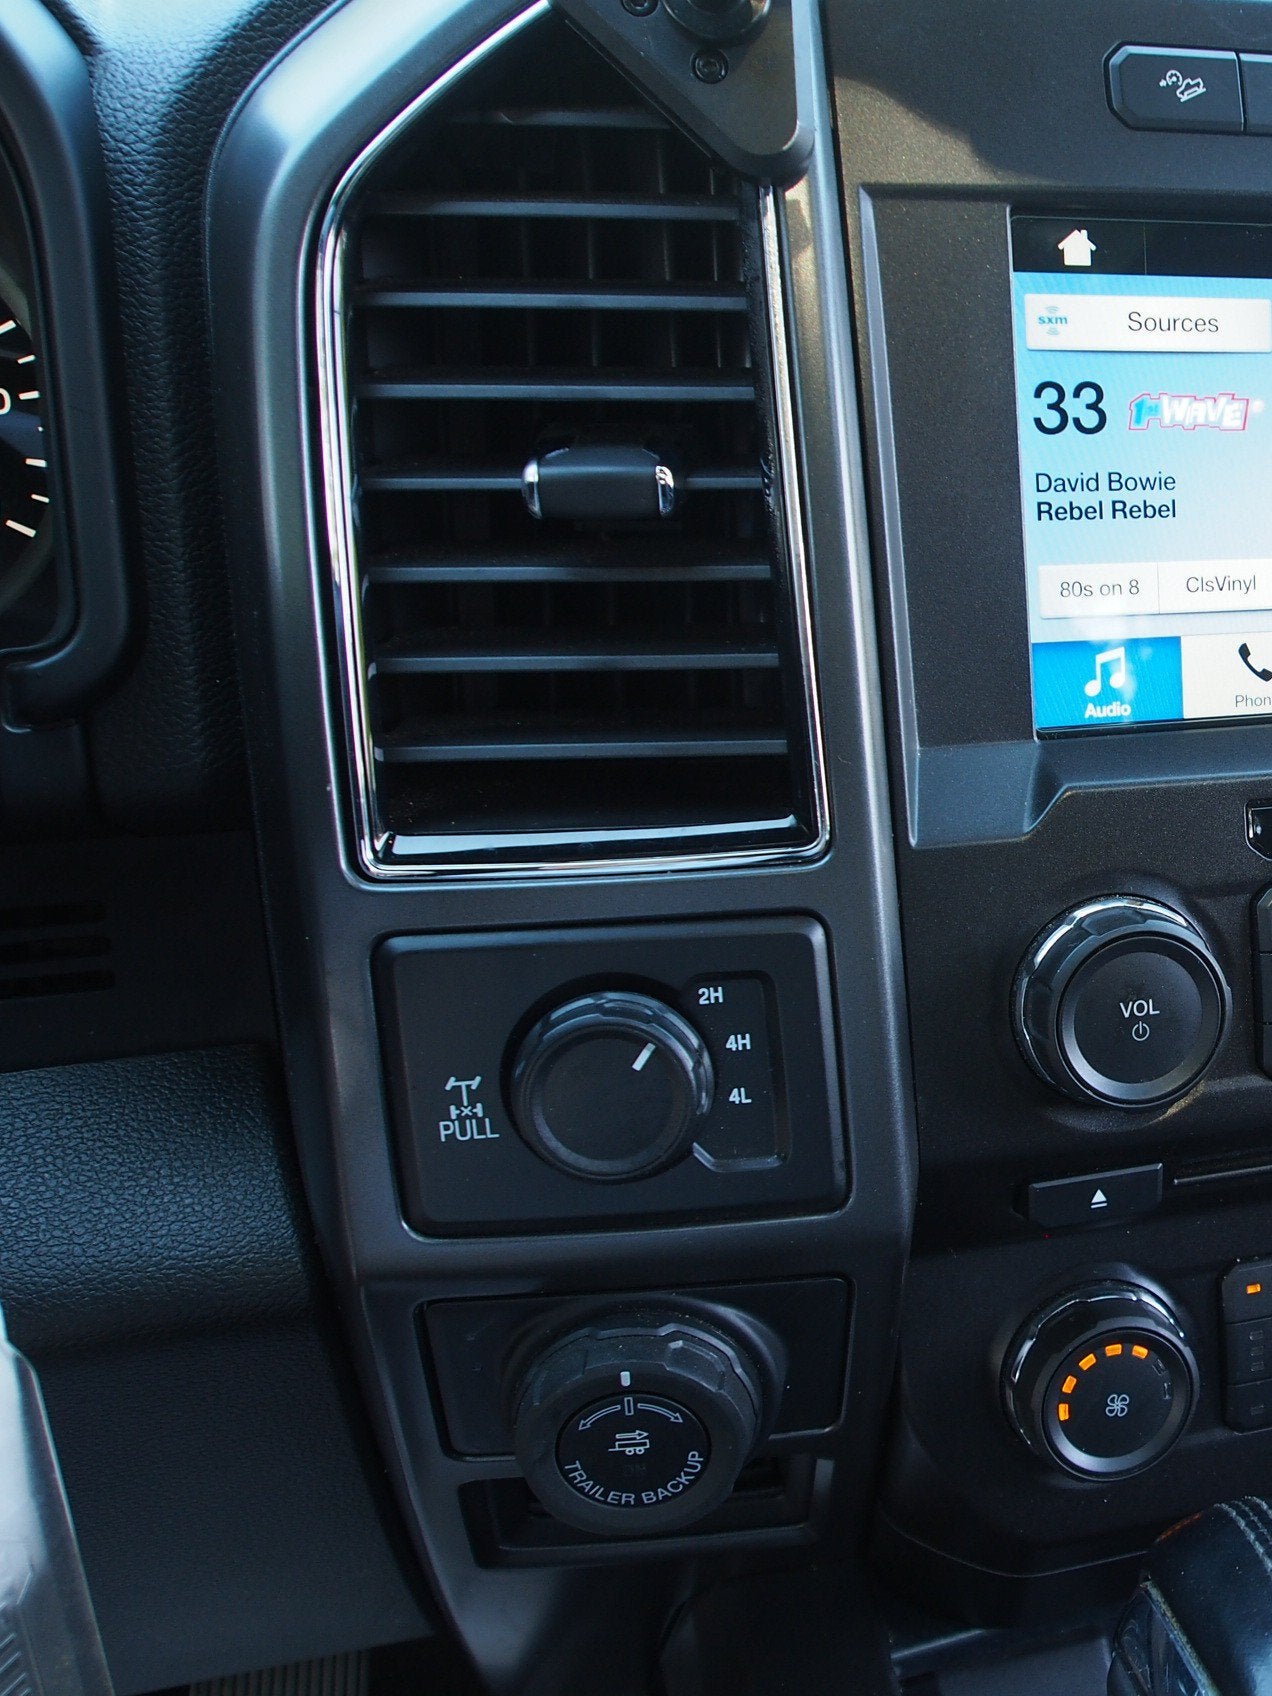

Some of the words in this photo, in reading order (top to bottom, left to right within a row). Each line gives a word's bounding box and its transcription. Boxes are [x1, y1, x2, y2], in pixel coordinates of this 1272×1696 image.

[1037, 314, 1069, 326] sxm
[1127, 311, 1220, 333] Sources
[1032, 380, 1108, 436] 33
[1034, 472, 1100, 493] David
[1107, 470, 1177, 492] Bowie
[1036, 501, 1104, 521] Rebel
[1110, 499, 1177, 520] Rebel
[1059, 581, 1094, 598] 80s
[1098, 582, 1123, 597] on
[1128, 579, 1140, 596] 8
[1185, 574, 1257, 595] ClsVinyl
[1084, 701, 1132, 719] Audio
[697, 986, 724, 1005] 2H
[1119, 998, 1160, 1018] VOL
[725, 1034, 751, 1051] 4H
[728, 1087, 752, 1105] 4L
[438, 1119, 500, 1142] PULL
[564, 1460, 636, 1506] TRAILER
[641, 1450, 705, 1505] BACKUP
